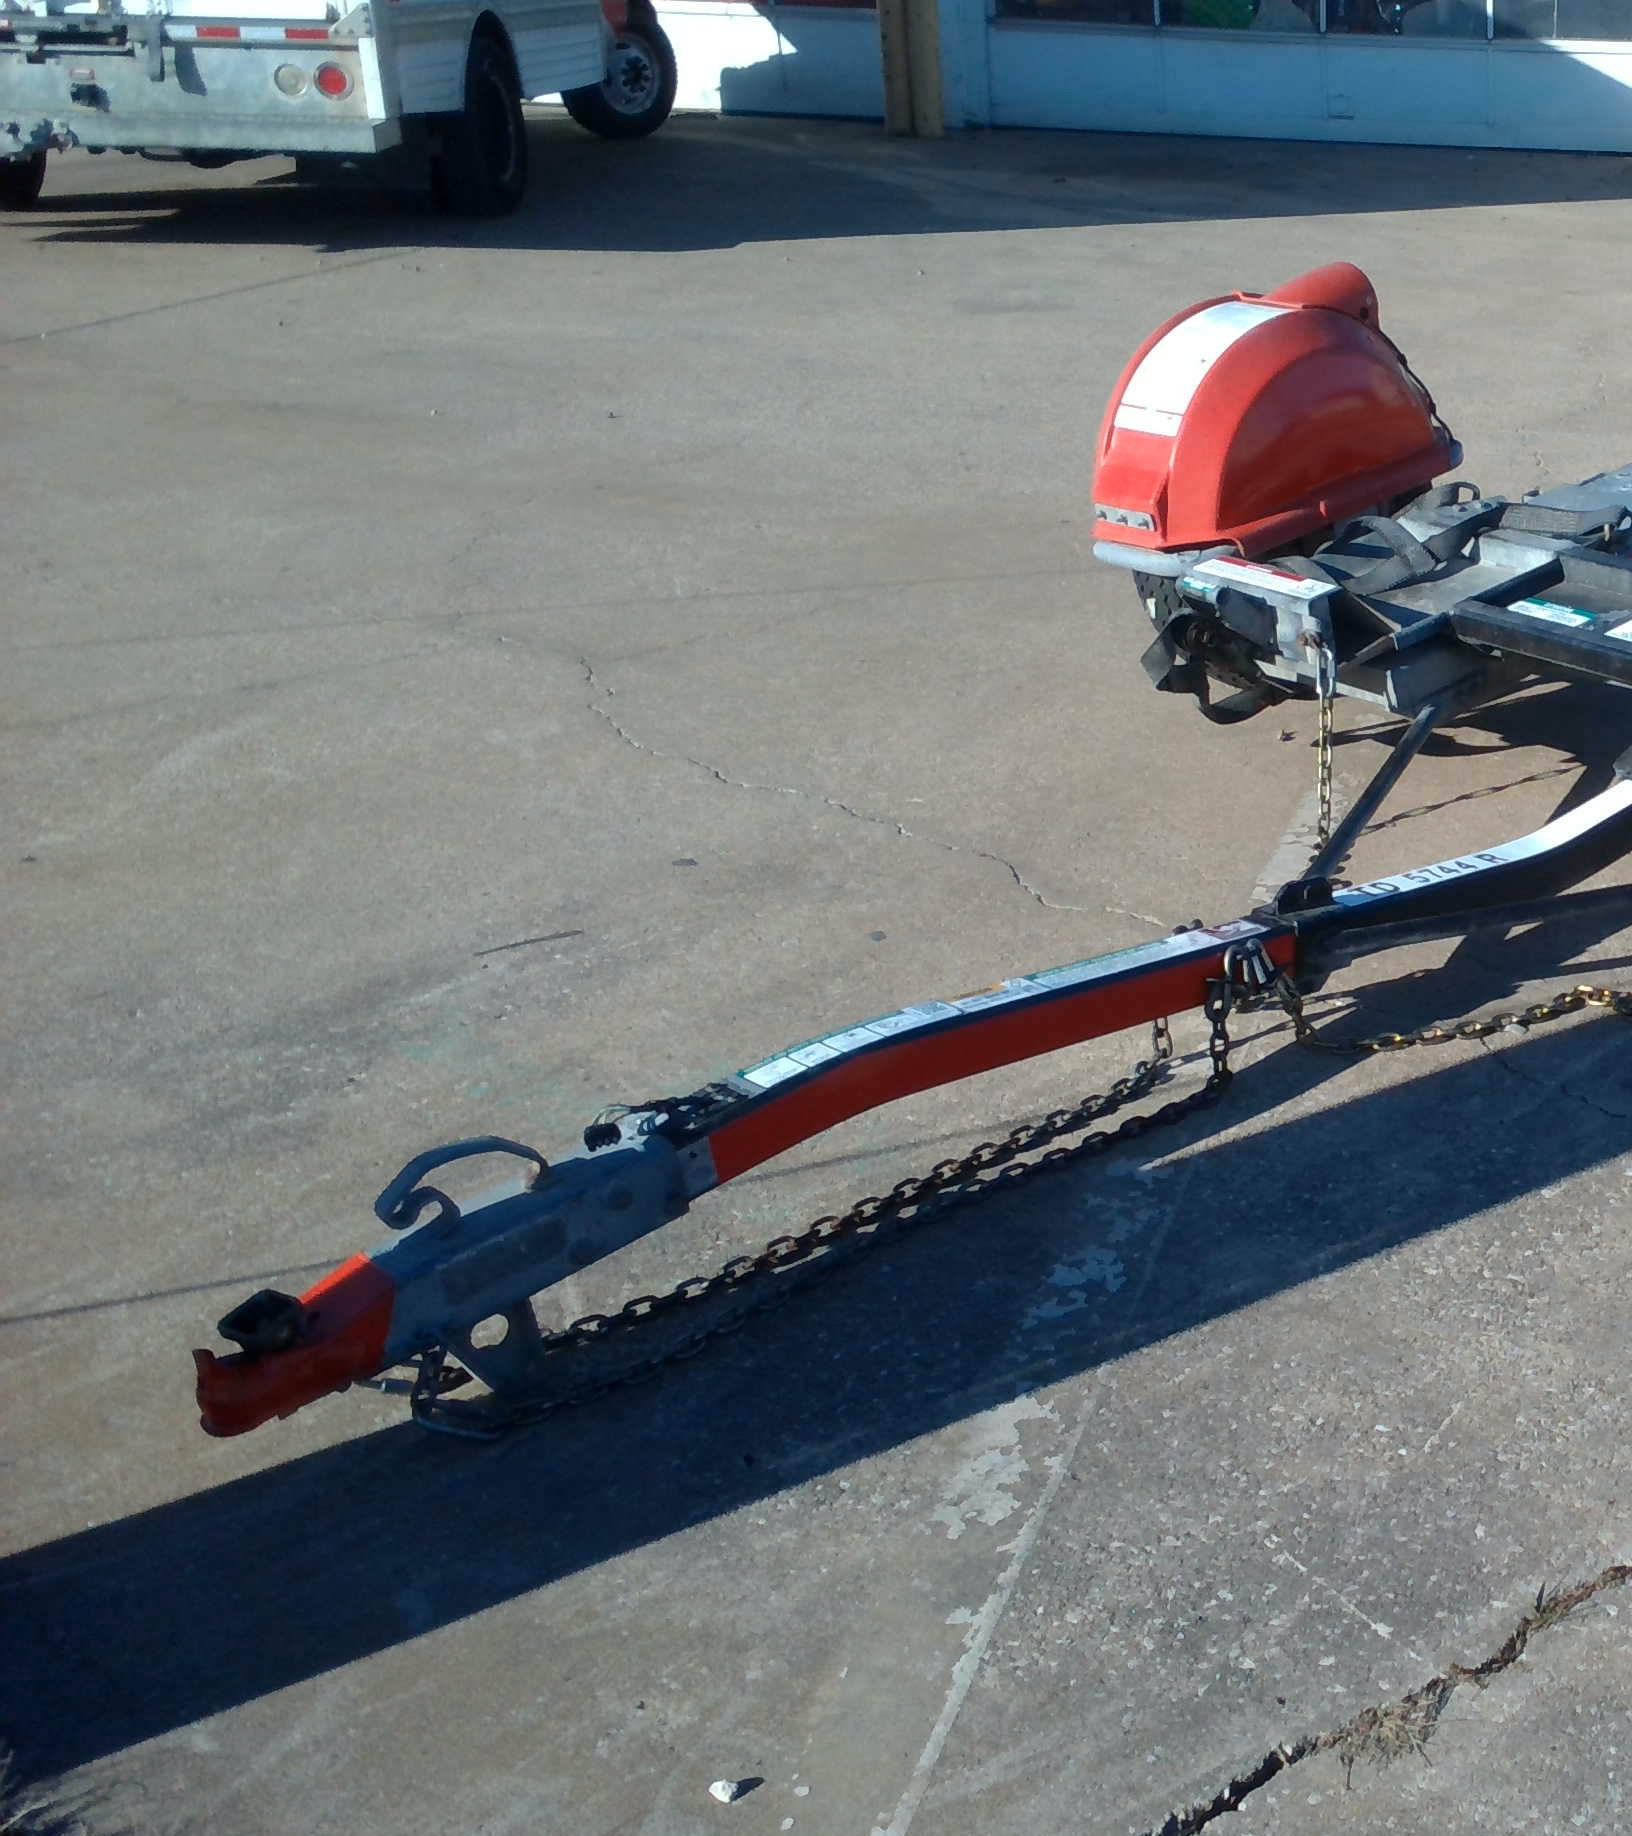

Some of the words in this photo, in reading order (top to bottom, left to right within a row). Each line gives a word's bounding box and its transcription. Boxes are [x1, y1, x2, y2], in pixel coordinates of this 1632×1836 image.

[1348, 881, 1401, 897] TD
[1401, 860, 1479, 884] 5744
[1475, 852, 1510, 865] R
